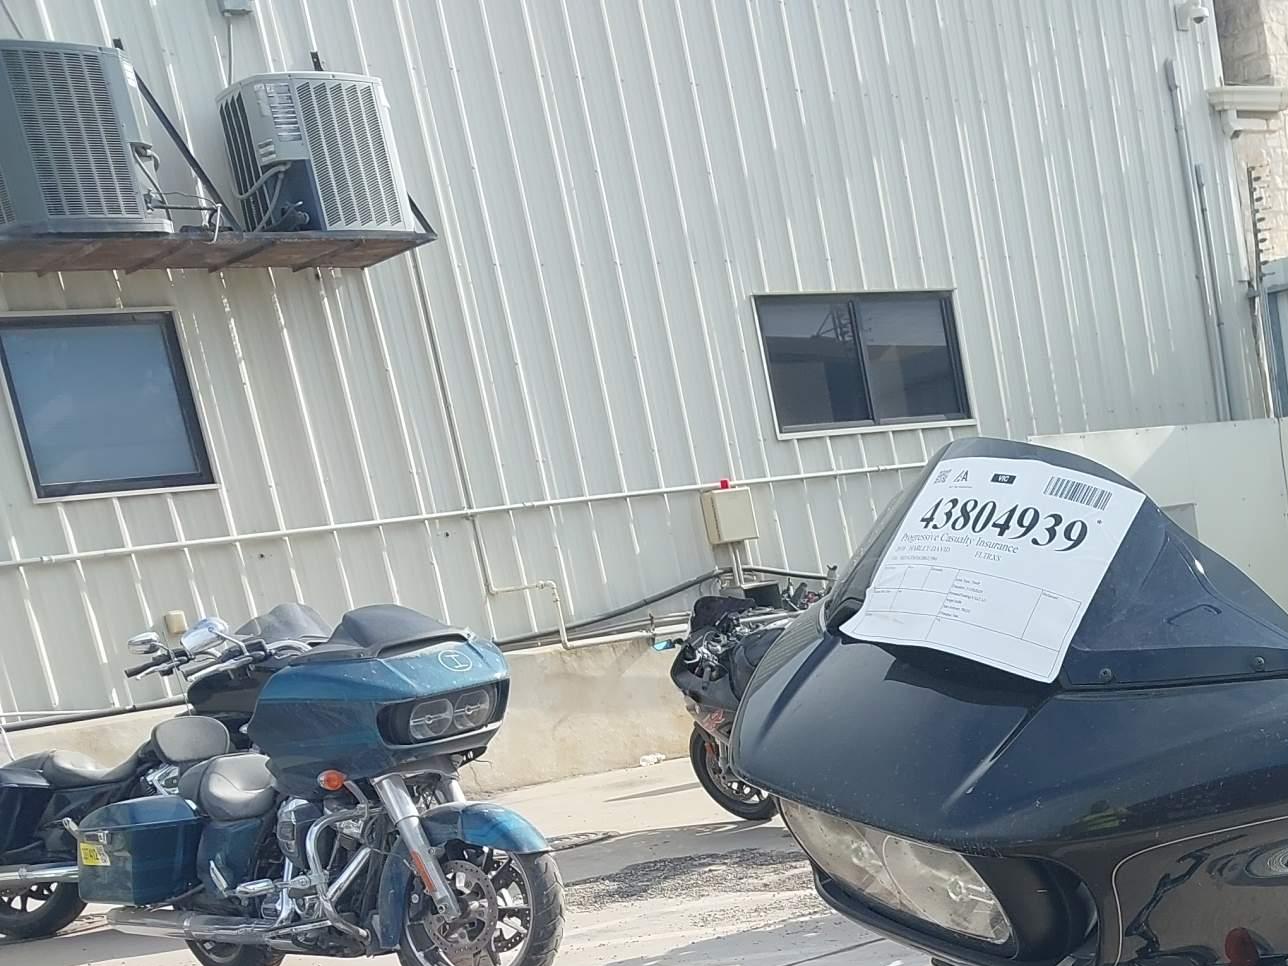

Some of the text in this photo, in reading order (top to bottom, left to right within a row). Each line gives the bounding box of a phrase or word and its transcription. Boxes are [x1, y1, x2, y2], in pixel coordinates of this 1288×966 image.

[920, 497, 1088, 552] 43804939
[940, 533, 974, 548] Casualty
[975, 536, 1019, 554] Insurance
